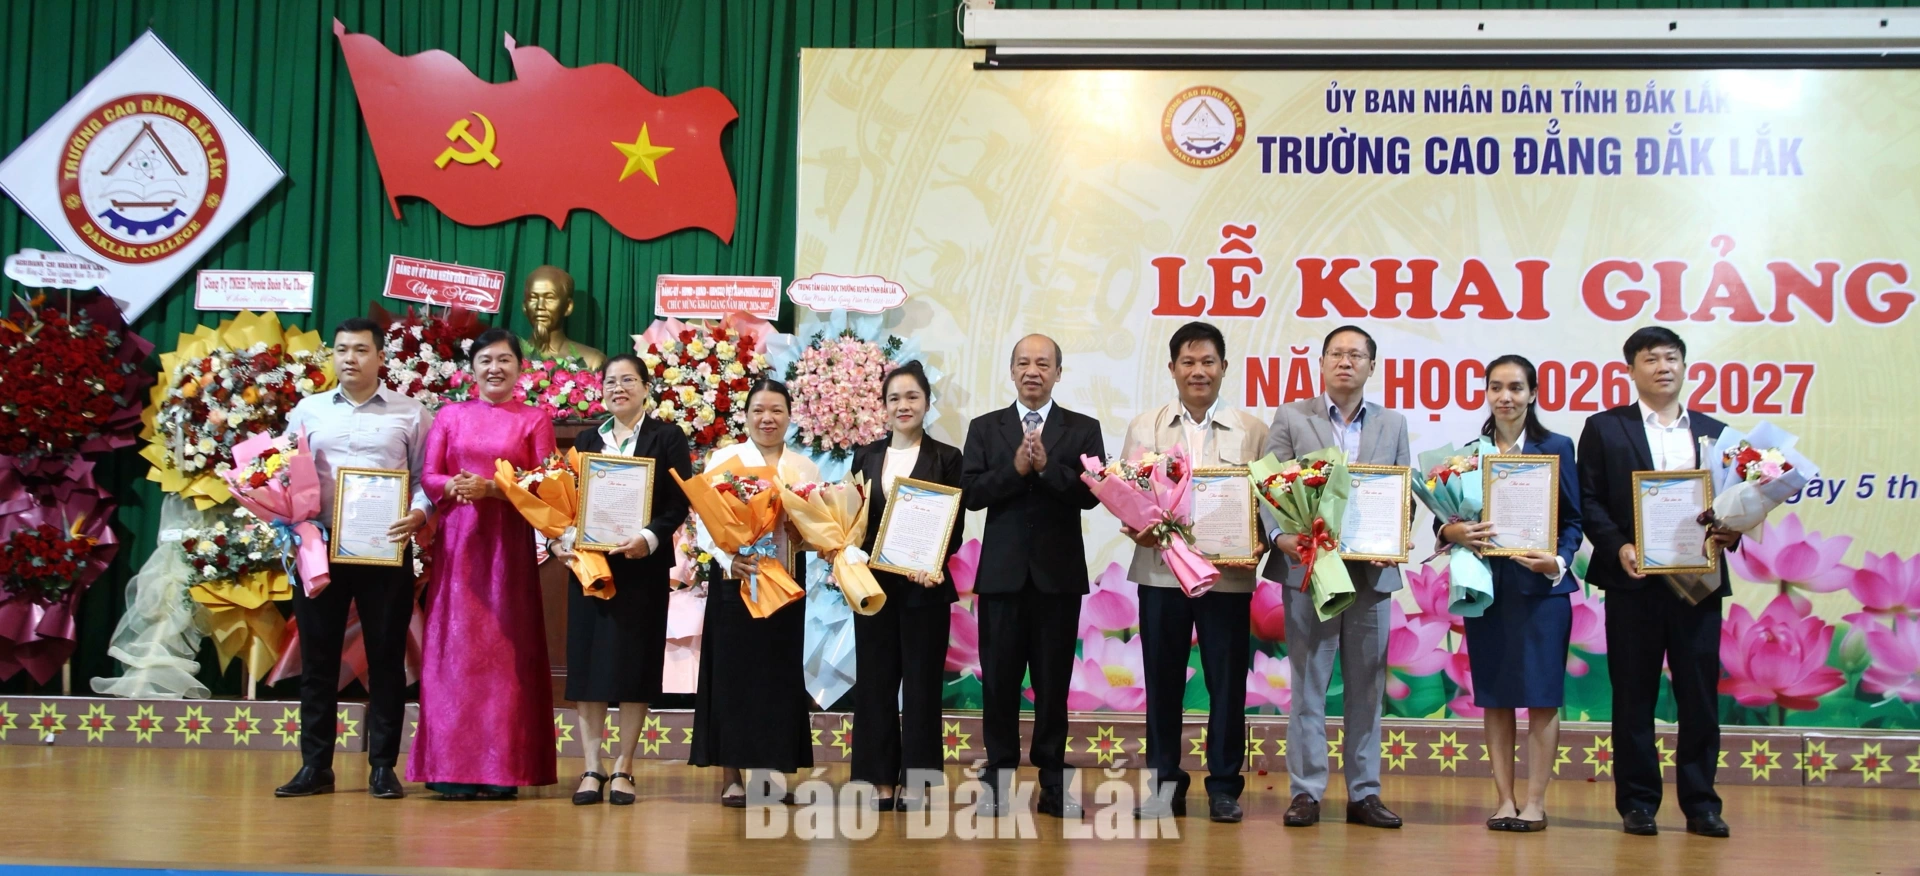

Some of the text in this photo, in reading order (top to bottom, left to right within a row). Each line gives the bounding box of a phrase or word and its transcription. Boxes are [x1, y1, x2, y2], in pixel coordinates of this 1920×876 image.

[1326, 81, 1730, 114] ỦY BAN NHÂN DÂN TỈNH ĐẮK LẮK
[64, 118, 104, 180] TRƯỜNG
[102, 100, 138, 123] CAO
[140, 95, 188, 121] ĐẲNG
[1173, 147, 1234, 166] DAKLAK COLLEGE
[1257, 118, 1804, 176] TRƯỜNG CAO ĐẲNG ĐẮK LẮK
[80, 219, 202, 259] DAKLAK COLLEGE
[427, 269, 438, 281] BAN
[1150, 223, 1916, 325] LỄ KHAI GIẢNG
[1246, 346, 1814, 421] NĂ HỌC 026 2027
[1856, 474, 1876, 499] 5
